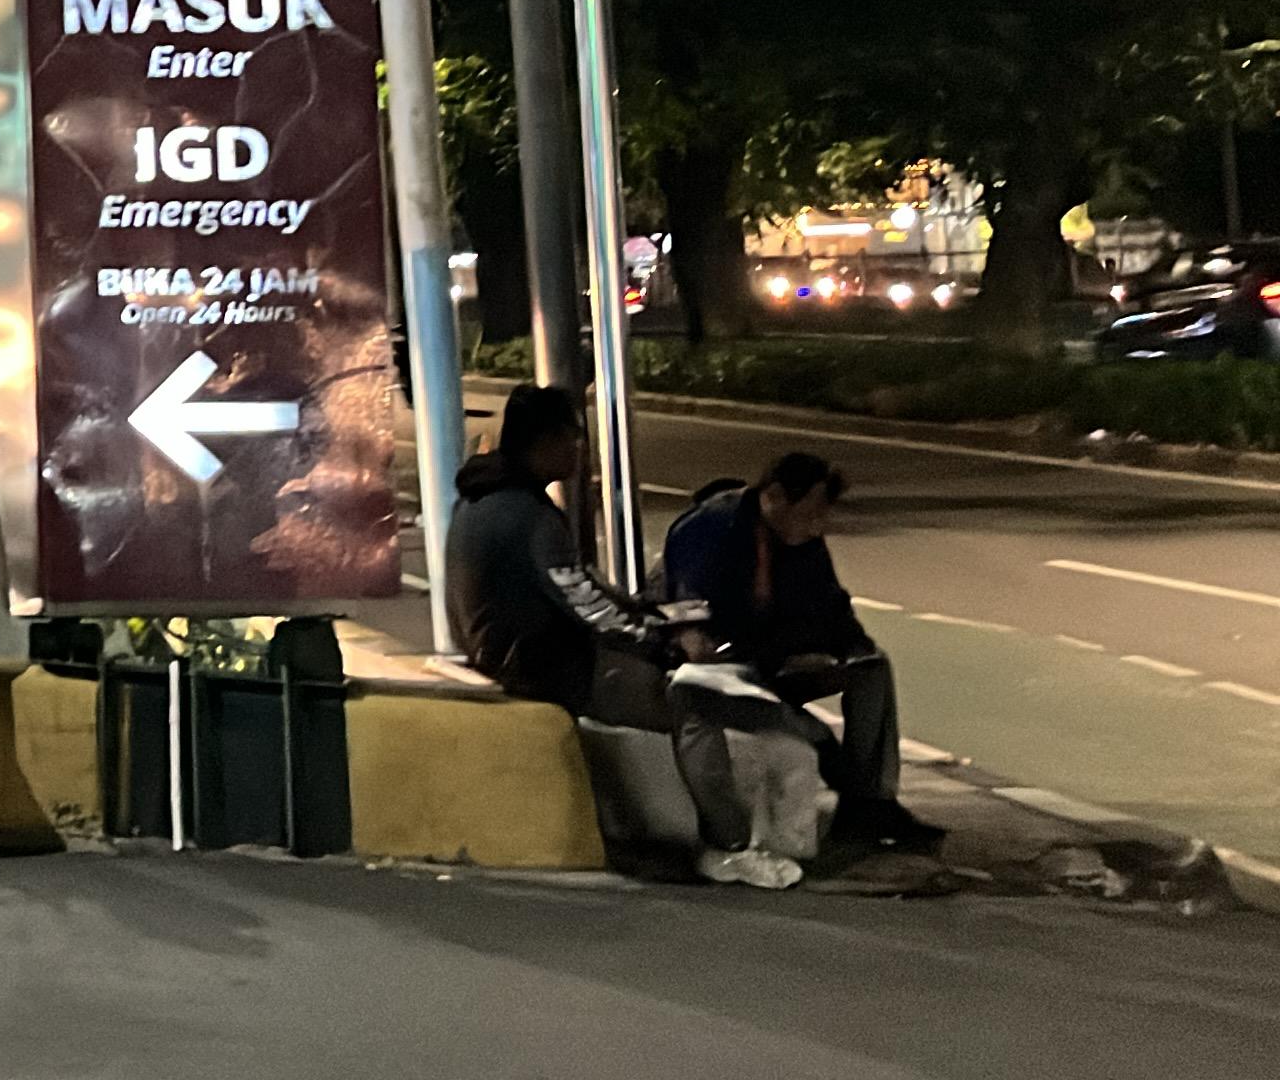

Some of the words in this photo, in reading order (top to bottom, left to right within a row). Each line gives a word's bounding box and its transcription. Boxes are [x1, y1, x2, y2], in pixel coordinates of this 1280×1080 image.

[147, 44, 253, 78] Enter
[134, 125, 270, 183] IGD
[98, 194, 313, 235] Emergency
[97, 268, 196, 297] BUKA
[200, 266, 244, 295] 24
[246, 267, 320, 302] JAM
[120, 303, 187, 329] Open
[189, 301, 222, 325] 24
[223, 301, 297, 325] Hours
